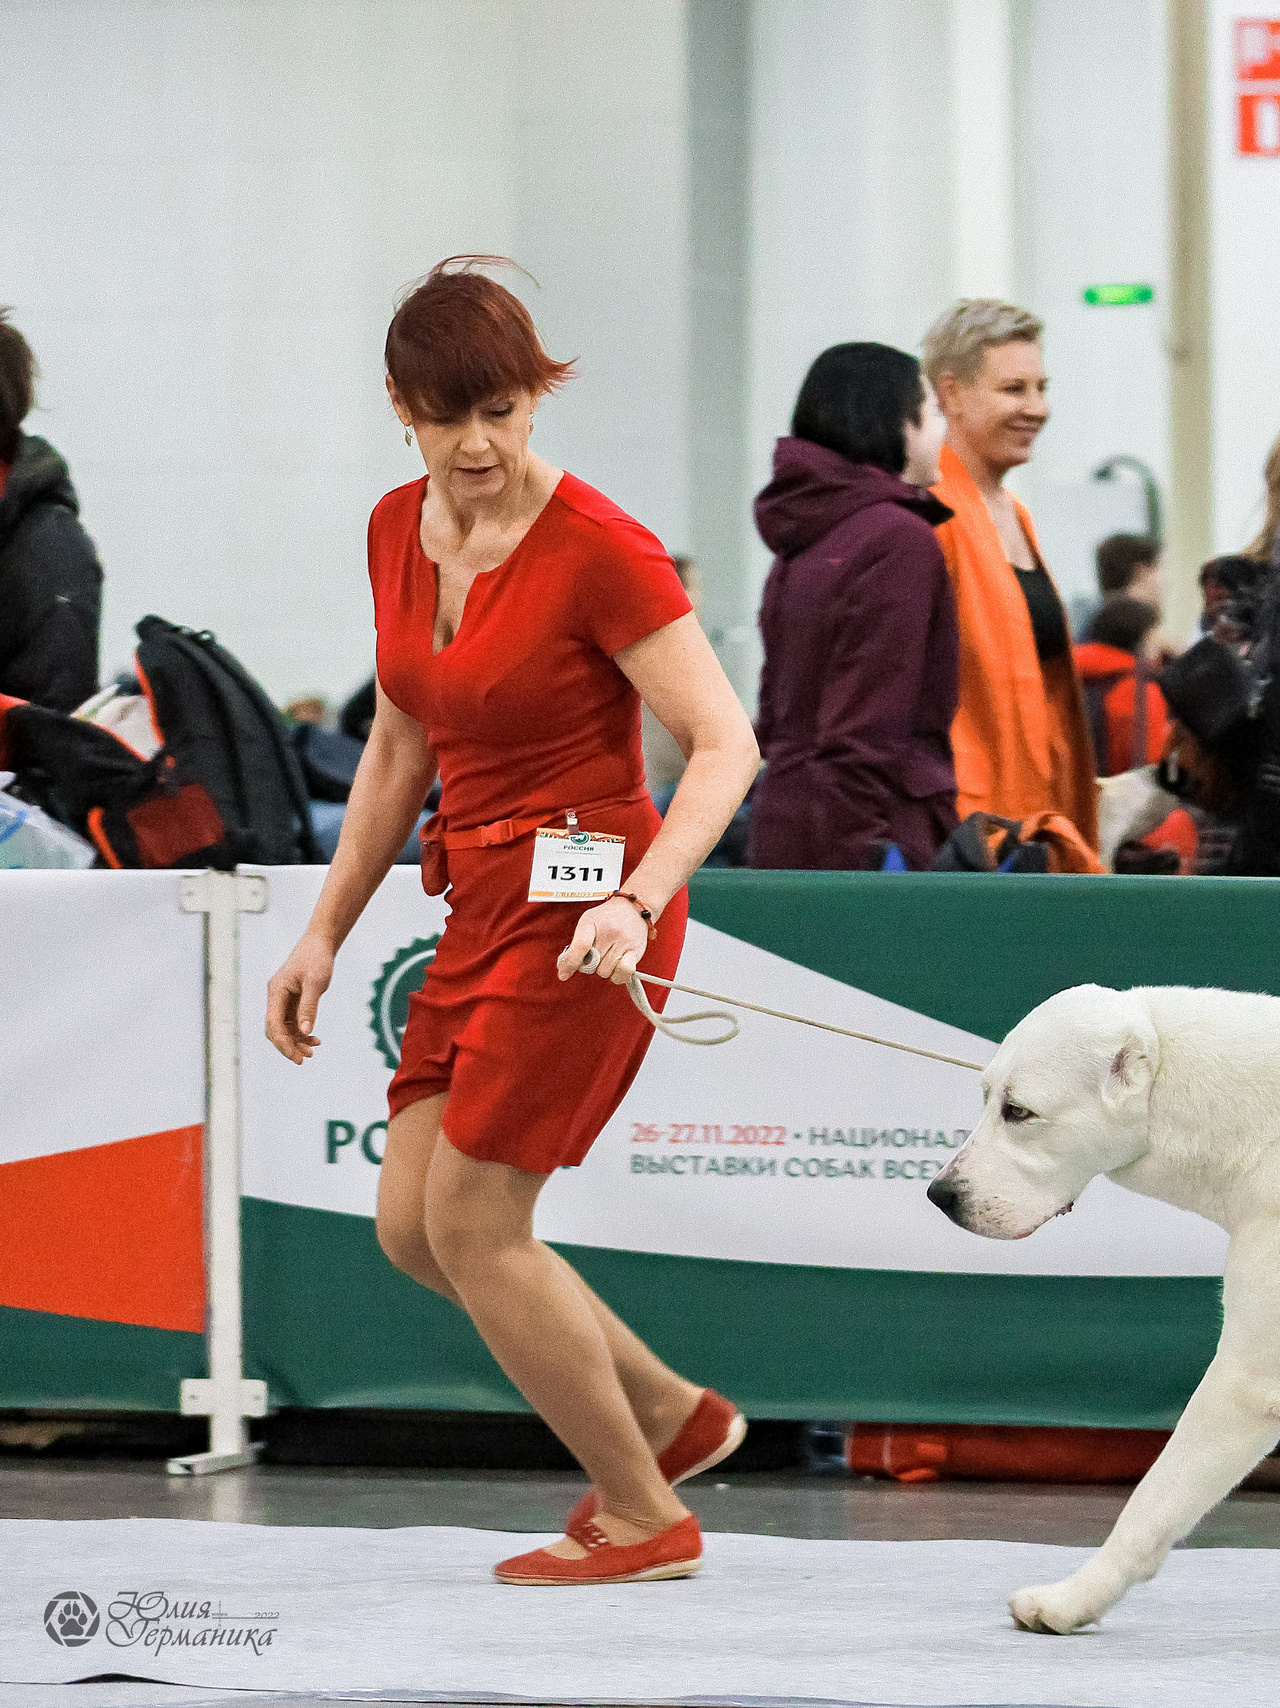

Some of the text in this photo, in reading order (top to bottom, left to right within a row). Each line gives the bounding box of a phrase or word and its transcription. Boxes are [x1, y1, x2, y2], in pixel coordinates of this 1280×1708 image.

[548, 865, 604, 882] 1311
[630, 1122, 787, 1146] 26-27.11.2022
[630, 1153, 777, 1177] ВЫСТАВКИ
[783, 1156, 876, 1180] СОБАК
